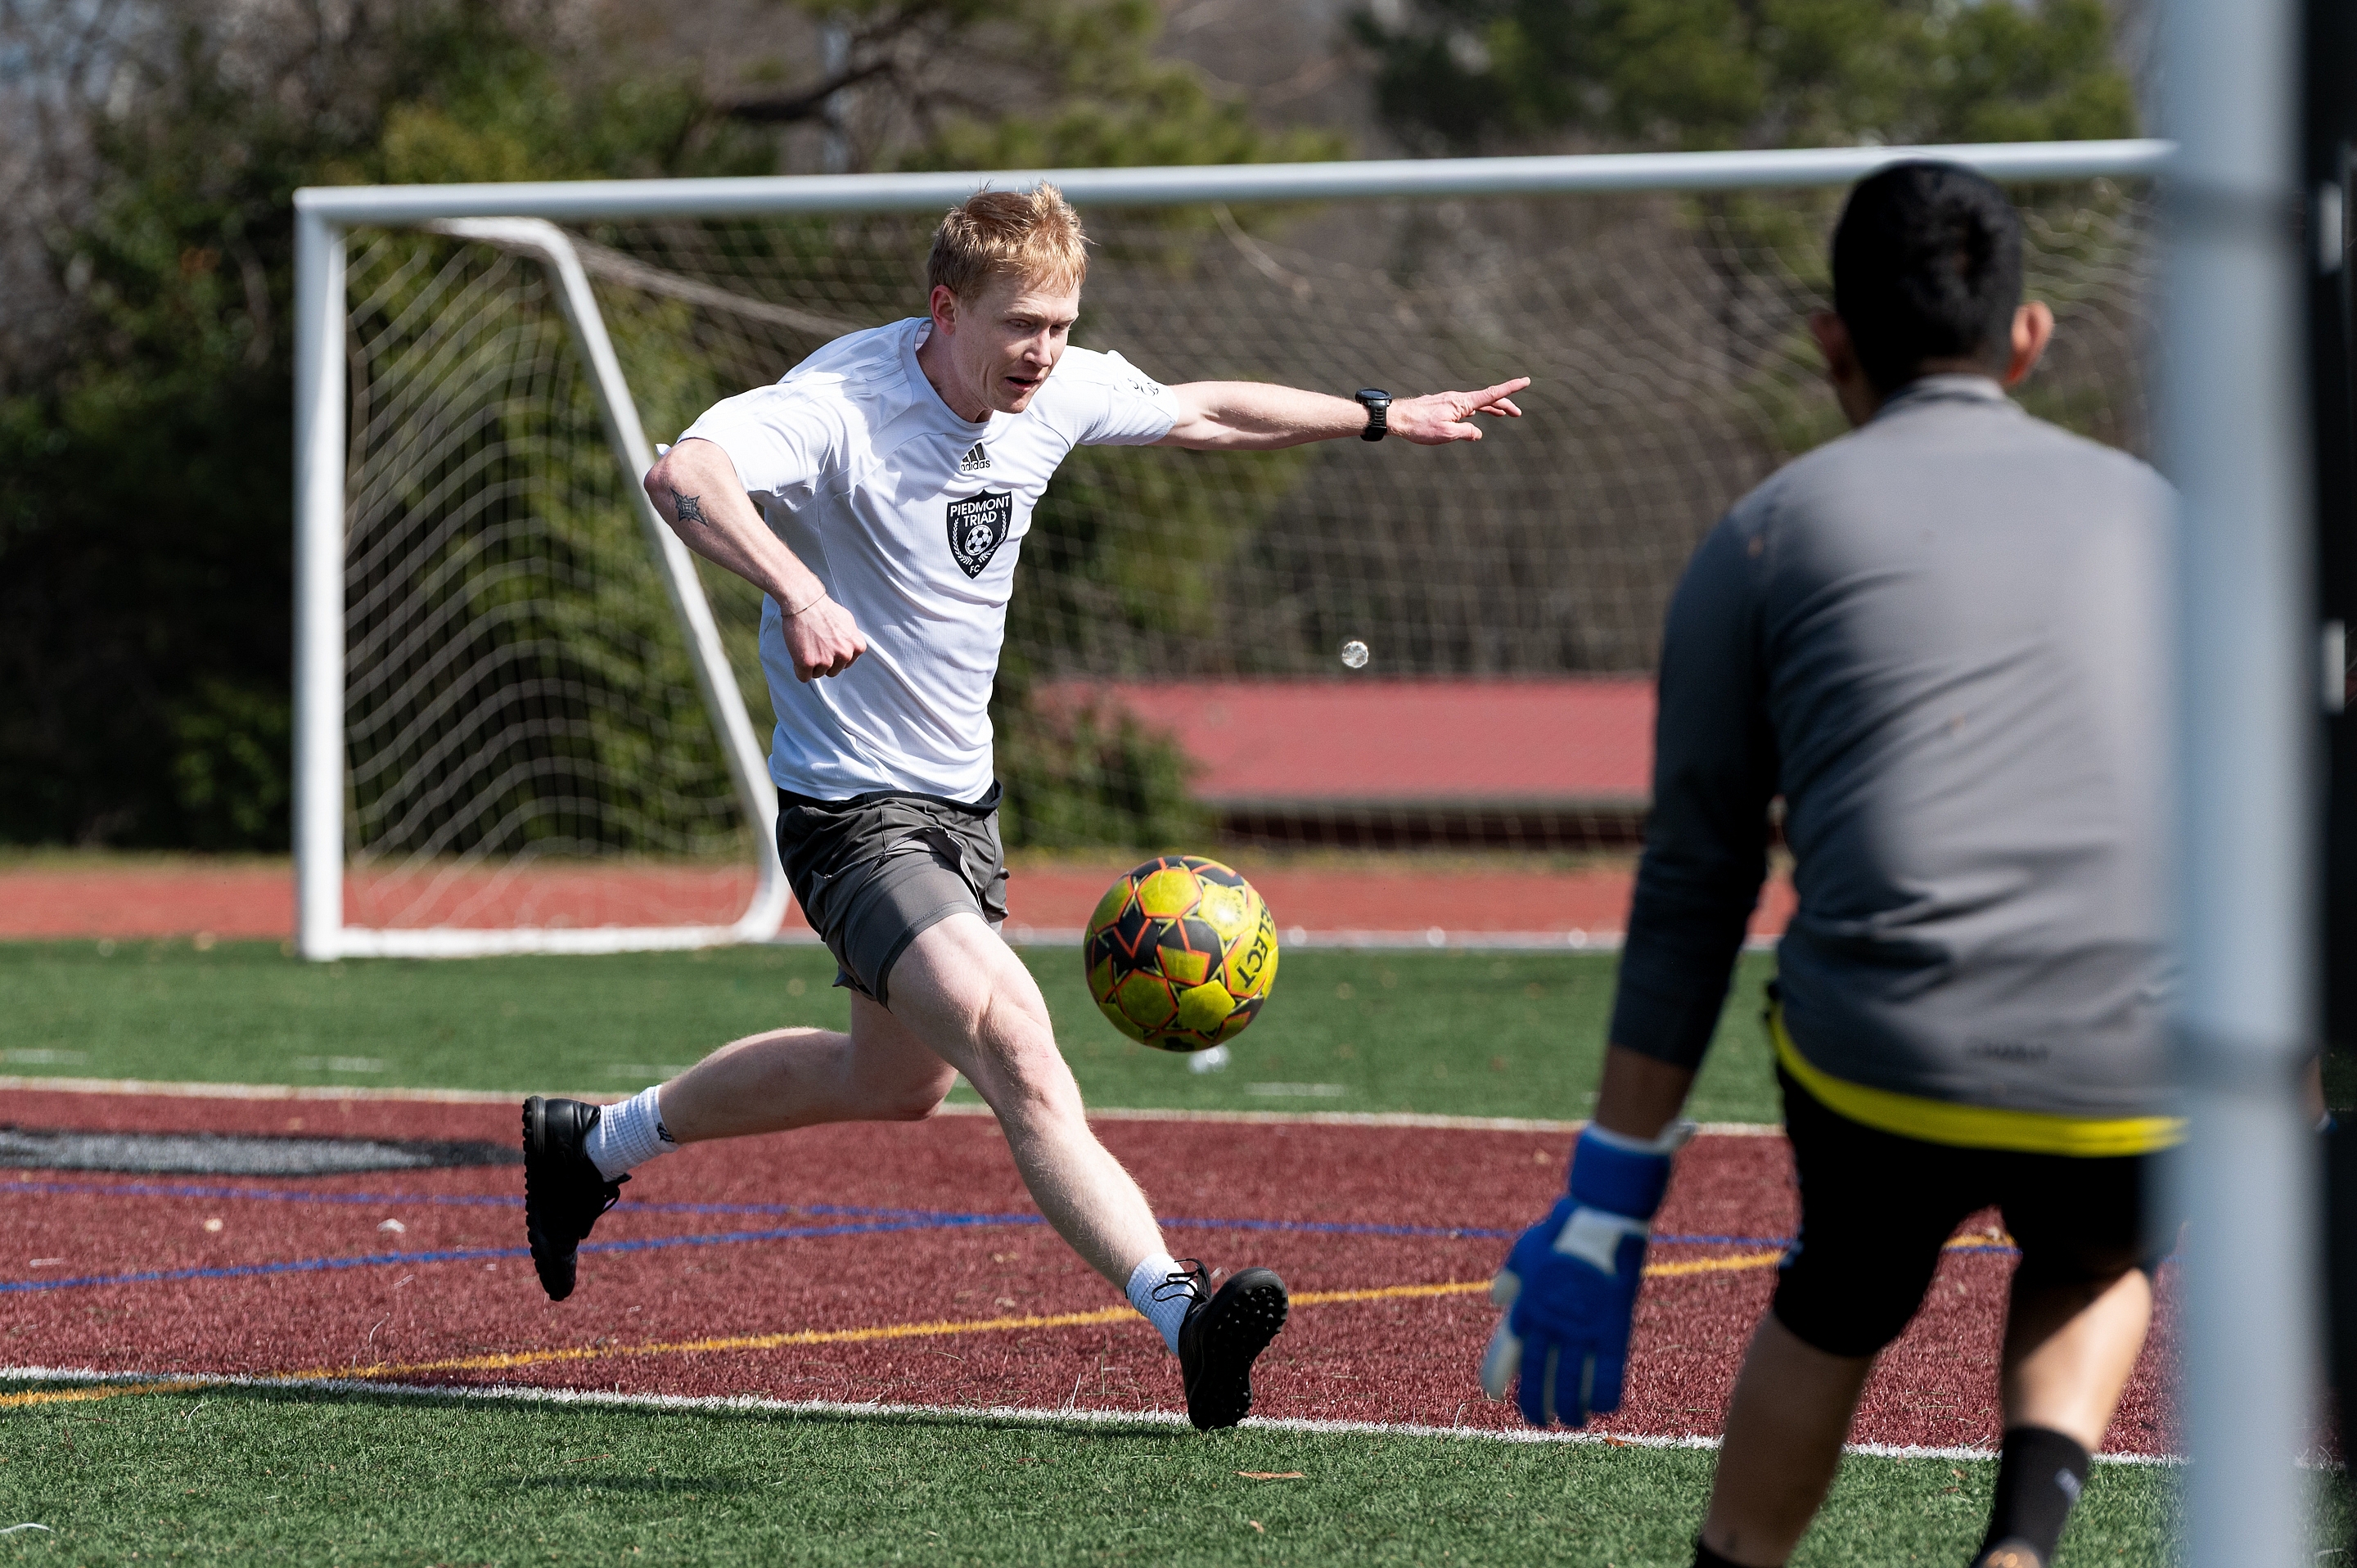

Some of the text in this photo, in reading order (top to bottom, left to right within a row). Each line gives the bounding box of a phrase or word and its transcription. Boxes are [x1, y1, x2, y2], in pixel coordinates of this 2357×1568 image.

[960, 460, 990, 471] adidas
[950, 496, 1010, 517] PIEDMONT
[963, 511, 997, 527] TRIAD
[969, 565, 980, 574] FC
